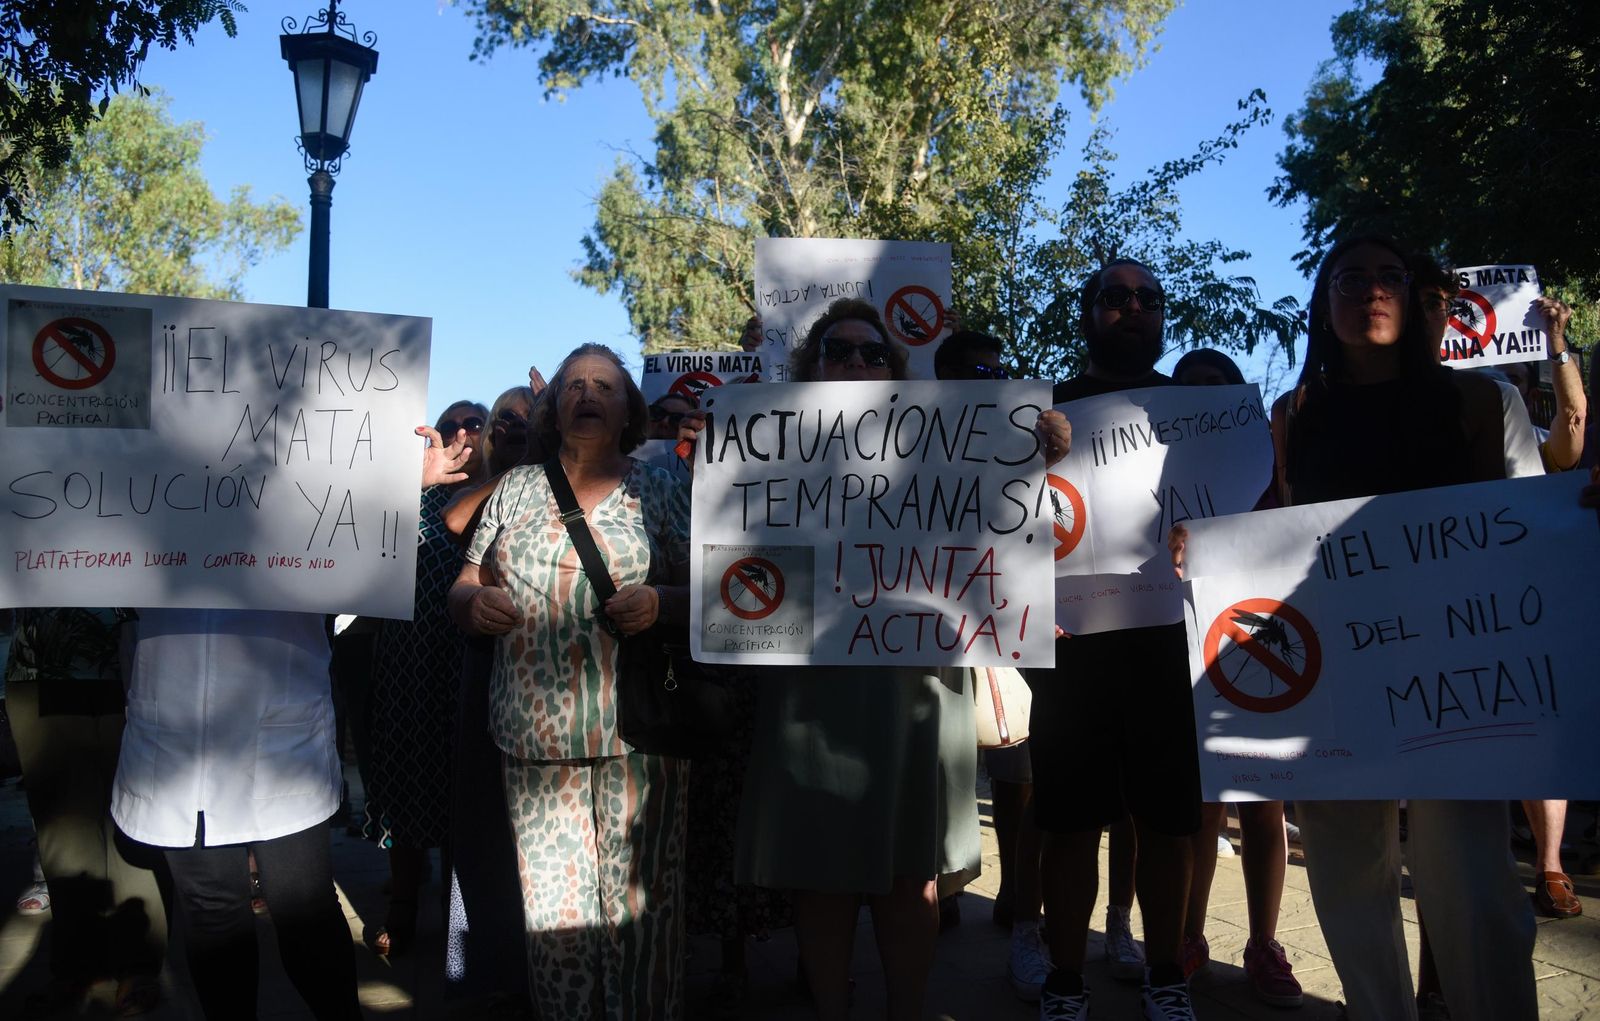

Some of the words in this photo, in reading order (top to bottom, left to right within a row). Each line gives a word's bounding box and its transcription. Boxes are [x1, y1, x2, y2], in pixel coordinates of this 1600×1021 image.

[1476, 268, 1530, 288] MATA
[645, 357, 662, 374] EL
[666, 355, 714, 373] VIRUS
[718, 355, 763, 373] MATA
[1440, 336, 1485, 362] UNA
[1491, 329, 1542, 356] YA!!!
[221, 403, 373, 470] MATA
[8, 464, 267, 519] SOLUCIÓN
[295, 481, 360, 552] YA
[732, 473, 1047, 544] TEMPRANAS!
[1402, 507, 1528, 563] VIRUS
[15, 549, 132, 572] PLATAFORMA
[144, 550, 188, 568] LUCHA
[203, 551, 257, 568] CONTRA
[847, 604, 1030, 660] ACTUA!
[1345, 616, 1420, 650] DEL
[1446, 584, 1543, 638] NILO
[1386, 654, 1560, 728] MATA!!
[1232, 773, 1261, 784] VIRUS
[1270, 770, 1295, 781] NILO
[1314, 749, 1353, 759] CONTRA
